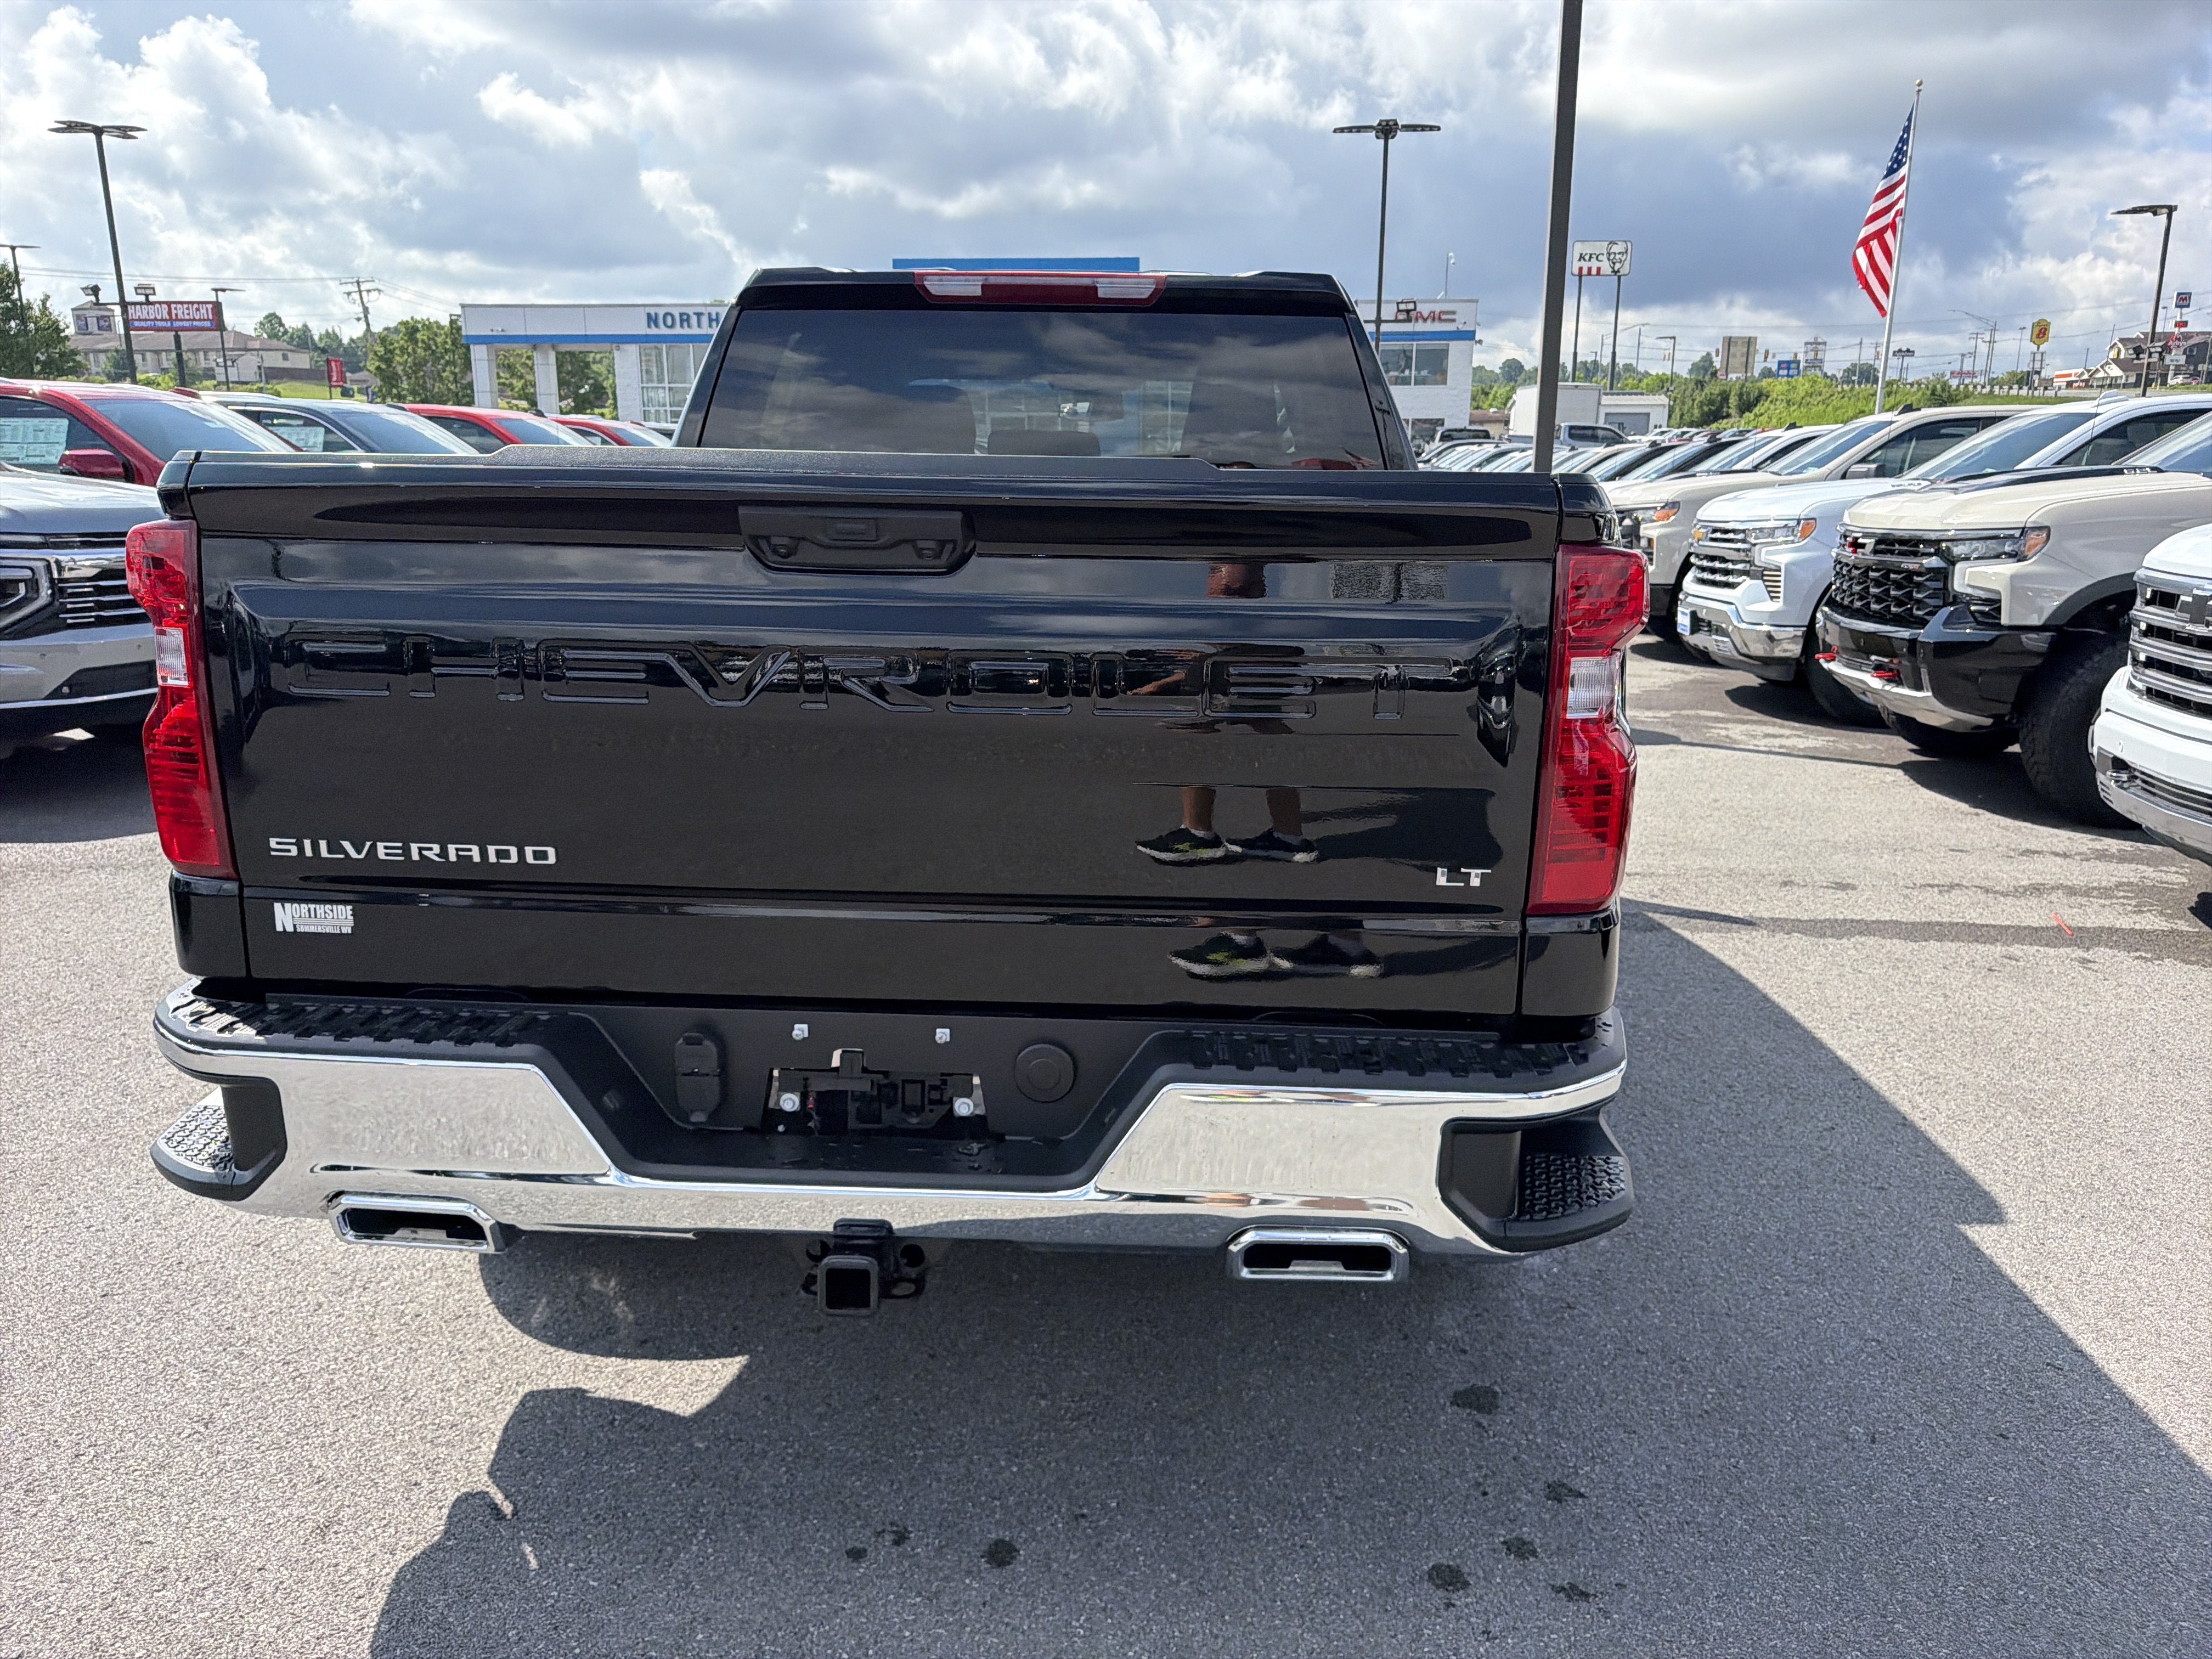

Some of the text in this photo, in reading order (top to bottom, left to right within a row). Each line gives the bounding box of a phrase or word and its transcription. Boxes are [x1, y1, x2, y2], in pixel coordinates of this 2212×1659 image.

[1577, 253, 1604, 262] KFC
[128, 303, 212, 320] HARBOR FREIGHT
[646, 312, 720, 329] NORTH
[2036, 327, 2047, 338] 8
[285, 631, 1453, 720] CHEVROLET
[269, 837, 556, 865] SILVERADO
[1436, 867, 1492, 887] LT
[274, 902, 354, 932] NORTHSIDE
[296, 924, 341, 933] SUMMERSVILLE
